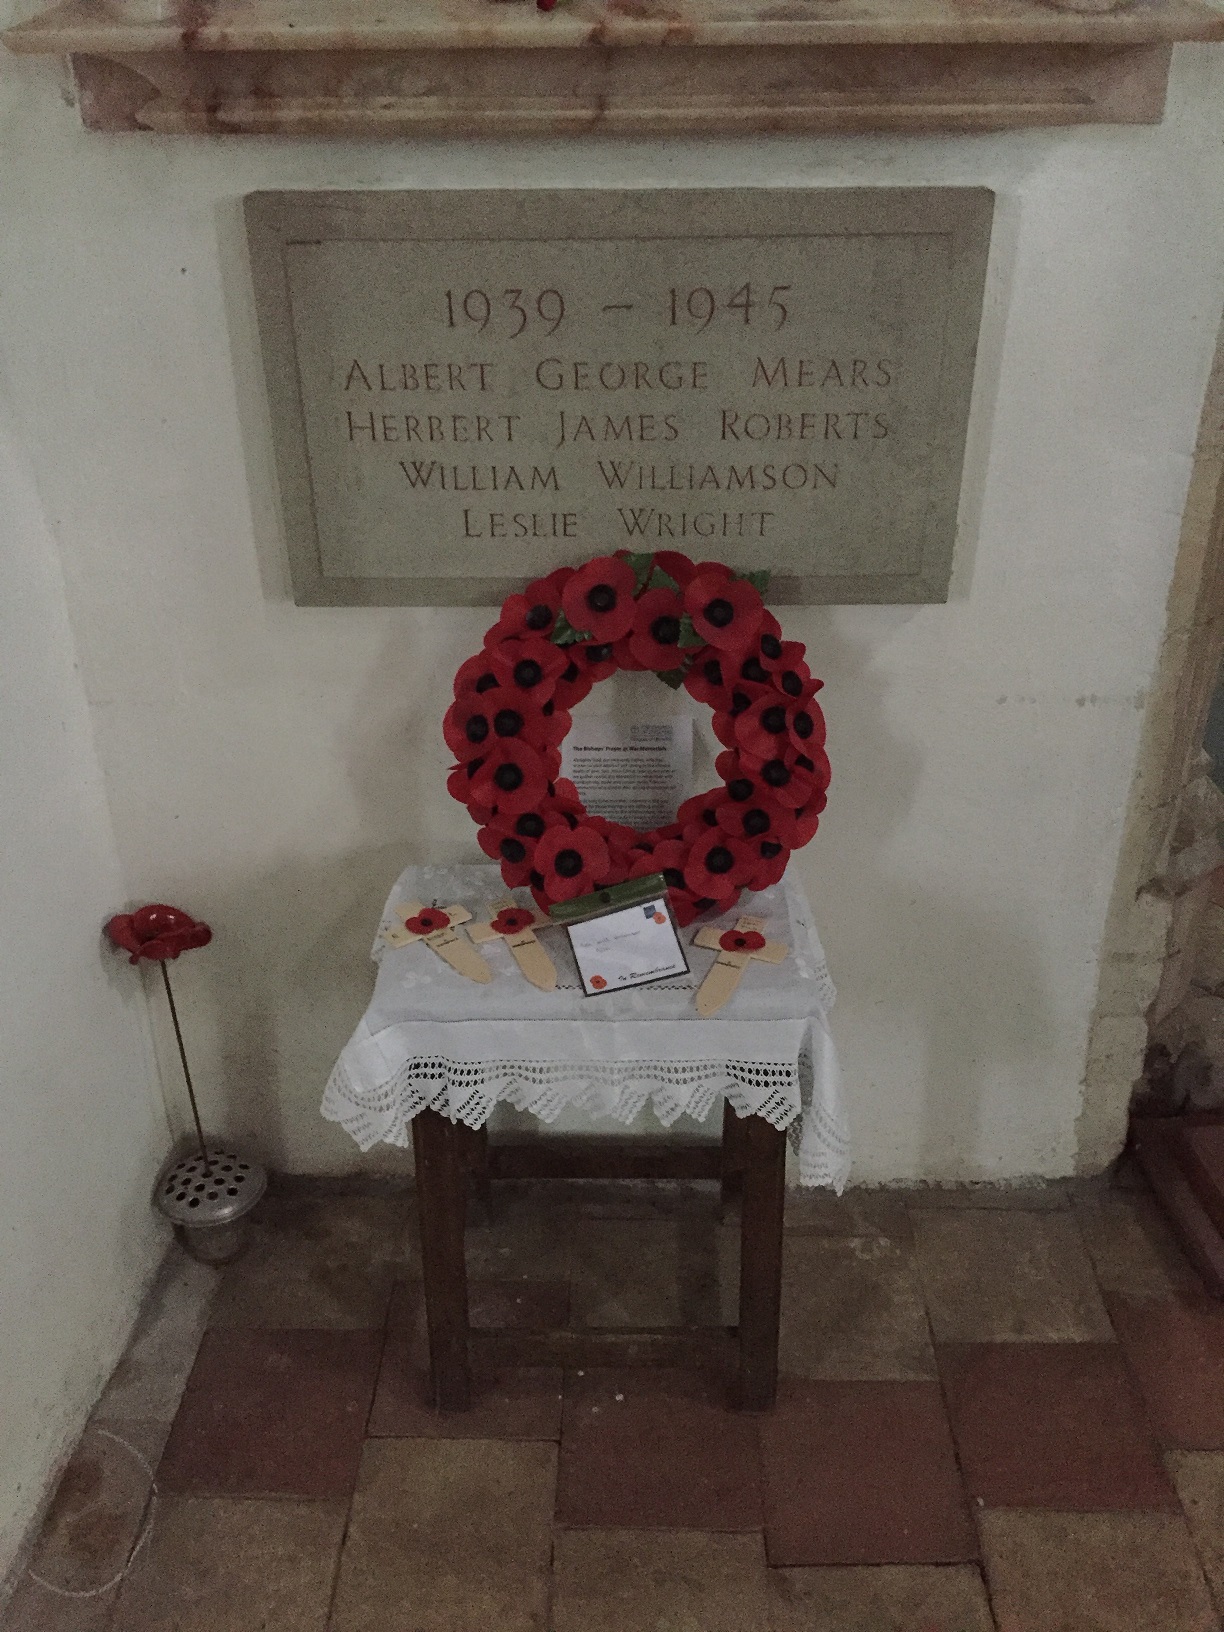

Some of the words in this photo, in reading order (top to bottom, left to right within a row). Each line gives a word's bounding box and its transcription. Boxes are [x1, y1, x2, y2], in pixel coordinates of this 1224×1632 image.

[444, 287, 566, 339] 1939
[669, 282, 794, 334] 1945
[344, 360, 495, 392] ALBERT
[536, 359, 710, 391] GEORGE
[752, 356, 895, 388] MEARS
[346, 411, 521, 443] HERBERT
[556, 411, 681, 448] JAMES
[721, 409, 892, 442] ROBERTS
[399, 461, 560, 491] WILLIAM
[598, 461, 838, 490] WILLIAMSON
[463, 509, 579, 538] LESLIE
[617, 508, 775, 537] WRIGHT
[629, 964, 676, 980] Remembrance
